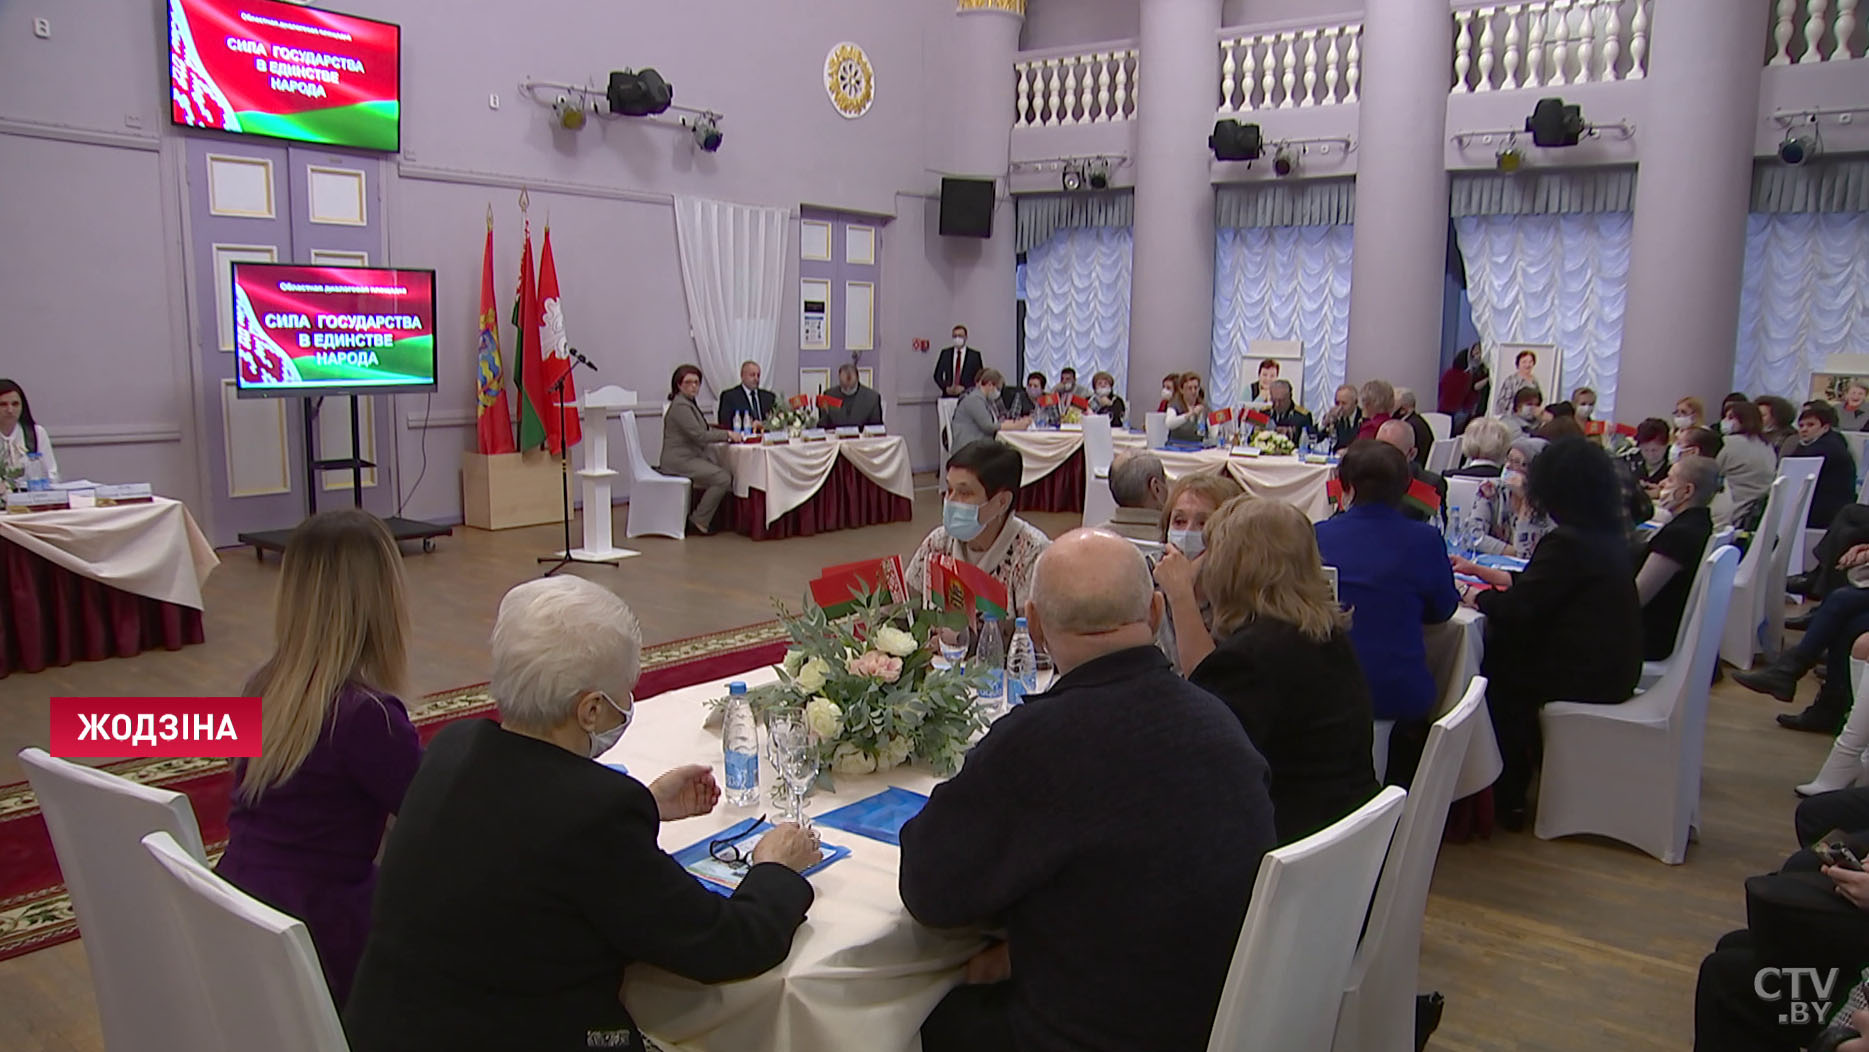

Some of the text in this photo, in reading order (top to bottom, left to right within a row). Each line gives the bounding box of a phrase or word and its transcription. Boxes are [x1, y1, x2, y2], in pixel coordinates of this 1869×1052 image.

[226, 37, 365, 73] СИЛА ГОСУДАРСТВА
[256, 59, 340, 84] В ЕДИНСТВЕ
[270, 77, 327, 98] НАРОДА
[264, 314, 423, 331] СИЛА ГОСУДАРСТВА
[298, 334, 394, 350] В ЕДИНСТВЕ
[316, 351, 379, 368] НАРОДА
